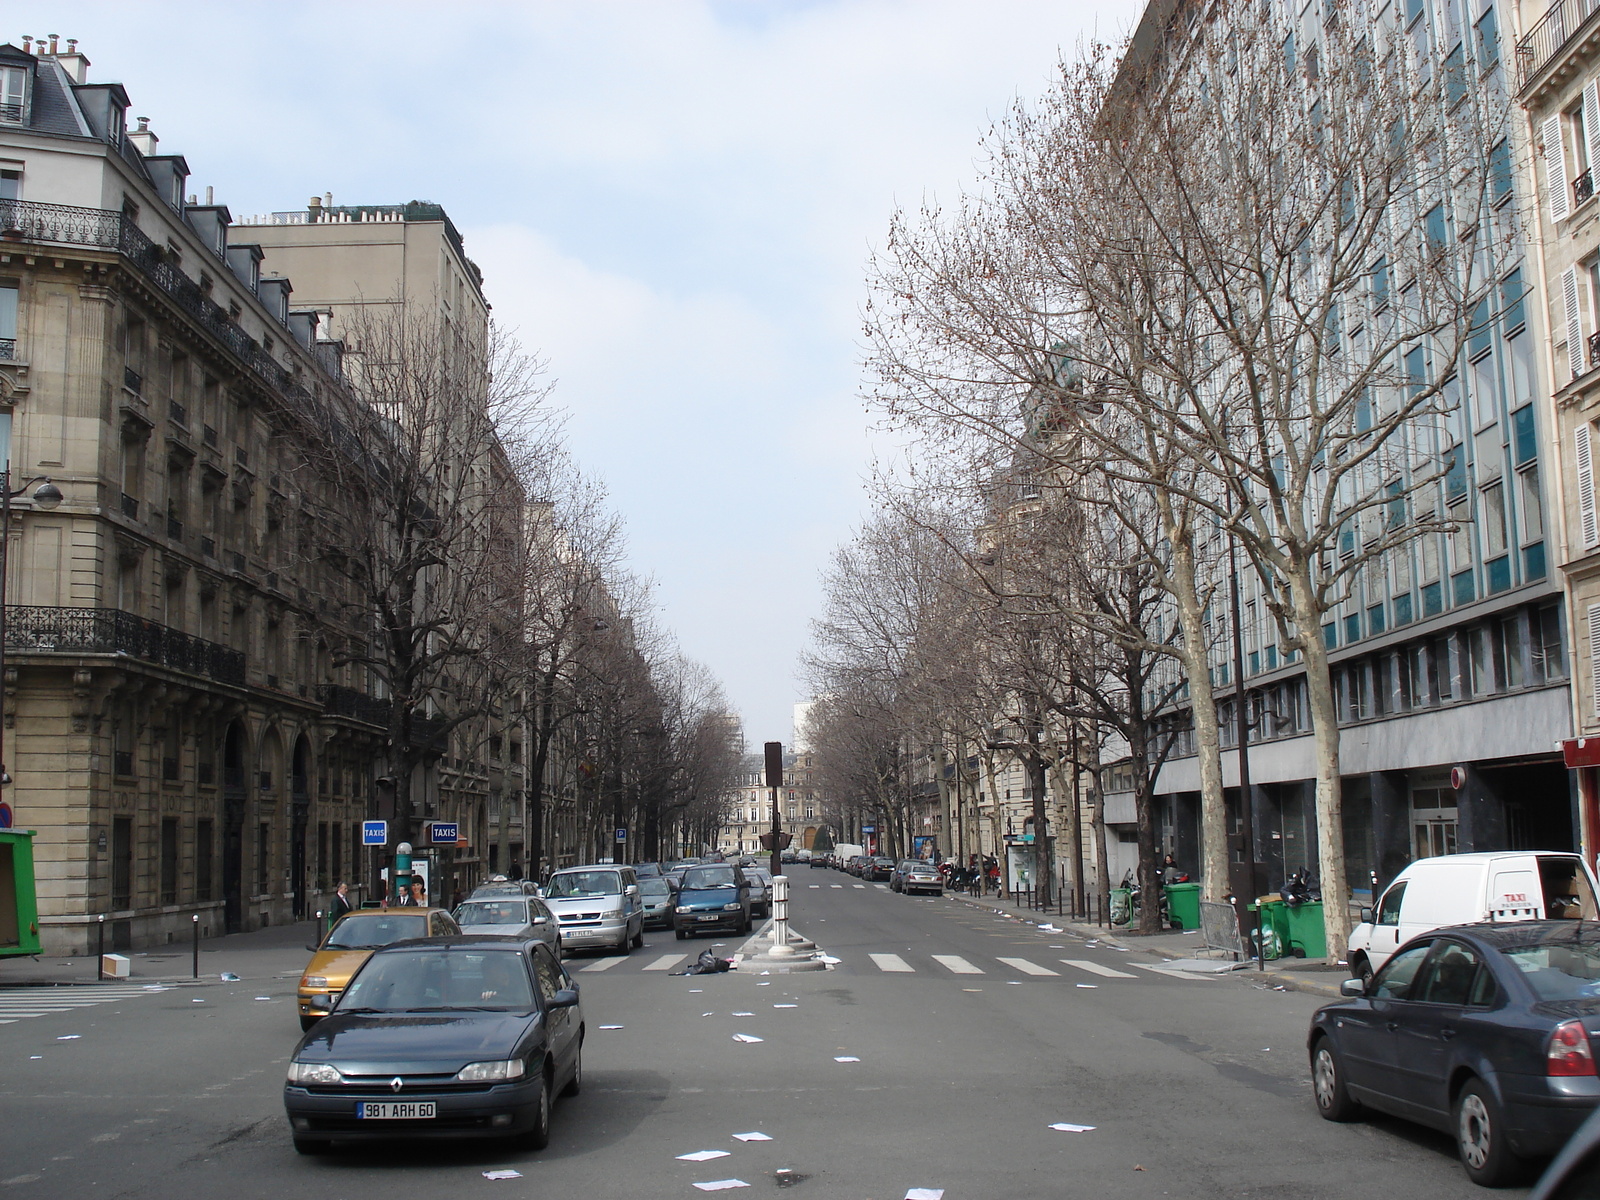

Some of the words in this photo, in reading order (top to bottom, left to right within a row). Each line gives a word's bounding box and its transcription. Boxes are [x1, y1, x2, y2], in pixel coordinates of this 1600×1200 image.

[365, 829, 384, 837] TAXIS
[434, 828, 456, 837] TAXIS
[1503, 893, 1527, 902] TAXI
[366, 1104, 386, 1117] 981
[392, 1104, 415, 1117] ARH
[419, 1104, 433, 1117] 60
